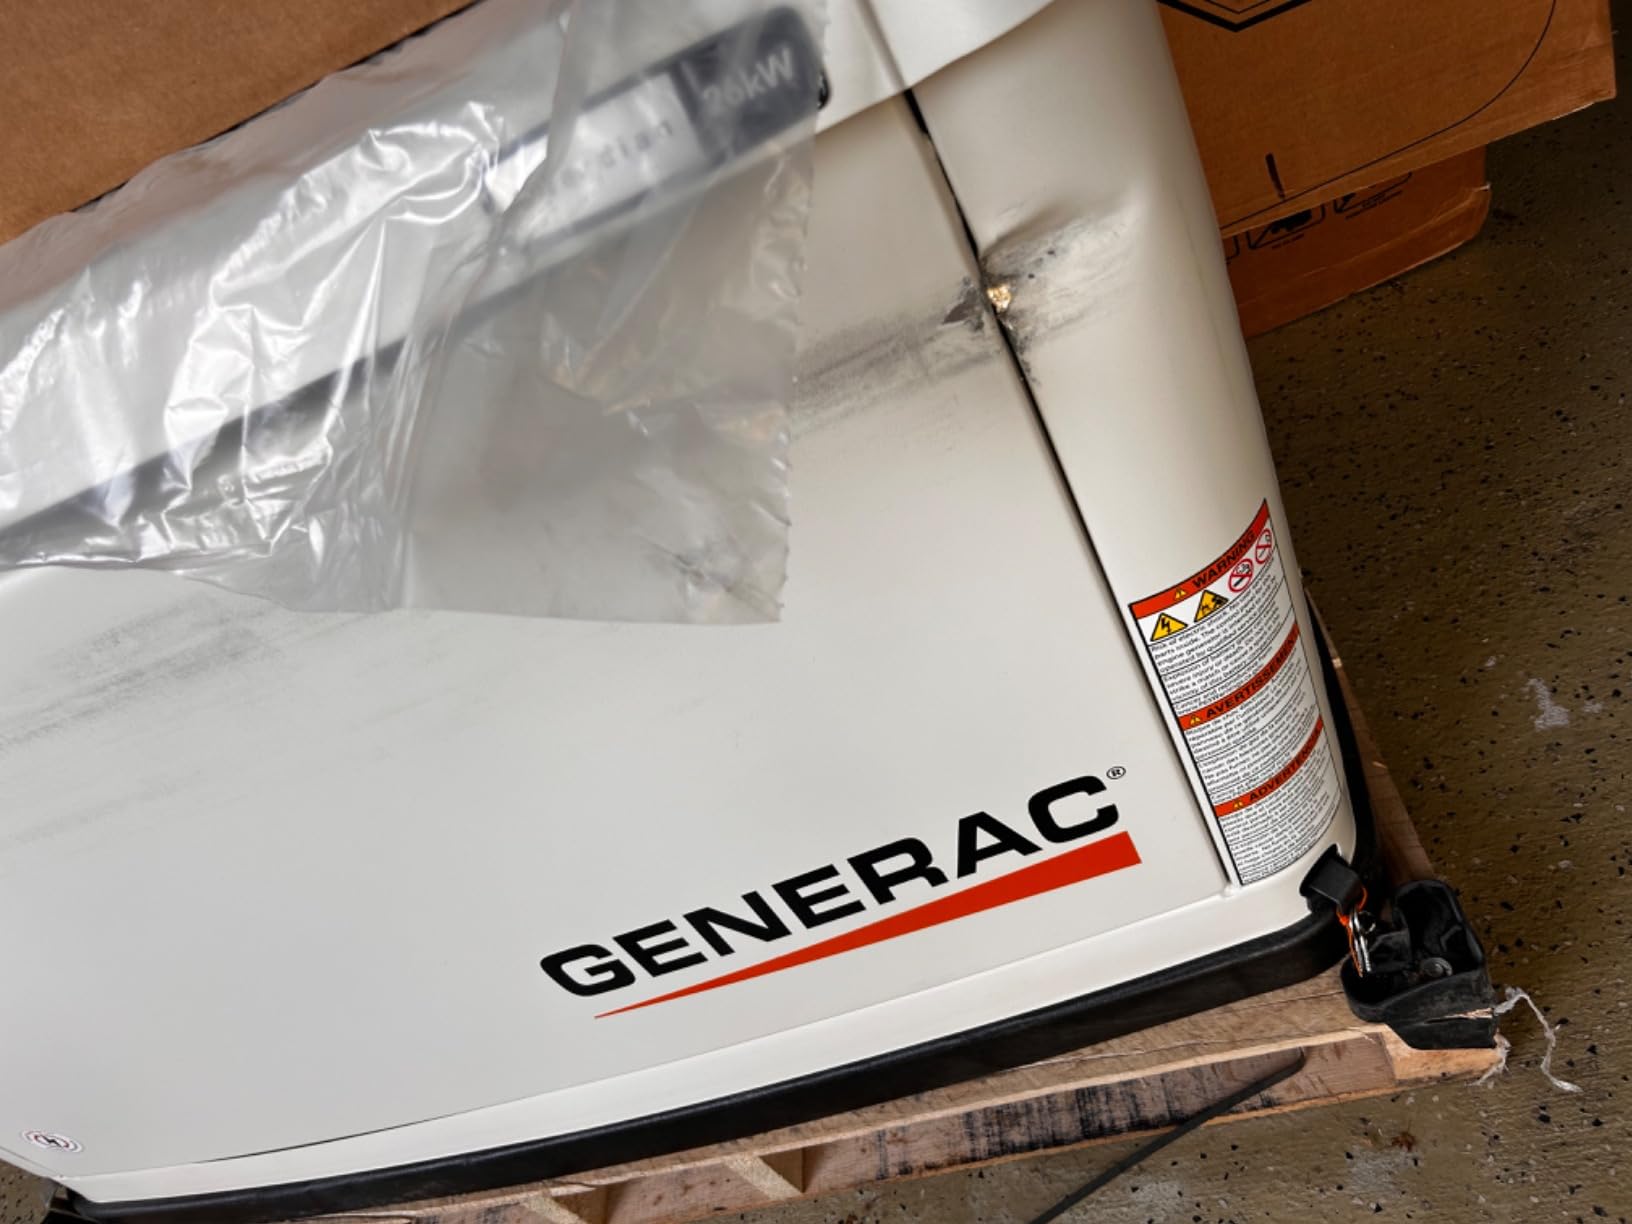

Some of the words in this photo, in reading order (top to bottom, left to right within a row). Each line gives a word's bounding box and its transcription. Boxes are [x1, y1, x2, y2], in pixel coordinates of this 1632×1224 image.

[1192, 528, 1255, 591] WARNING
[1205, 624, 1298, 720] AVERTISSEMENT
[1249, 723, 1320, 805] ADVERTENCIA
[540, 775, 1118, 997] GENERAC
